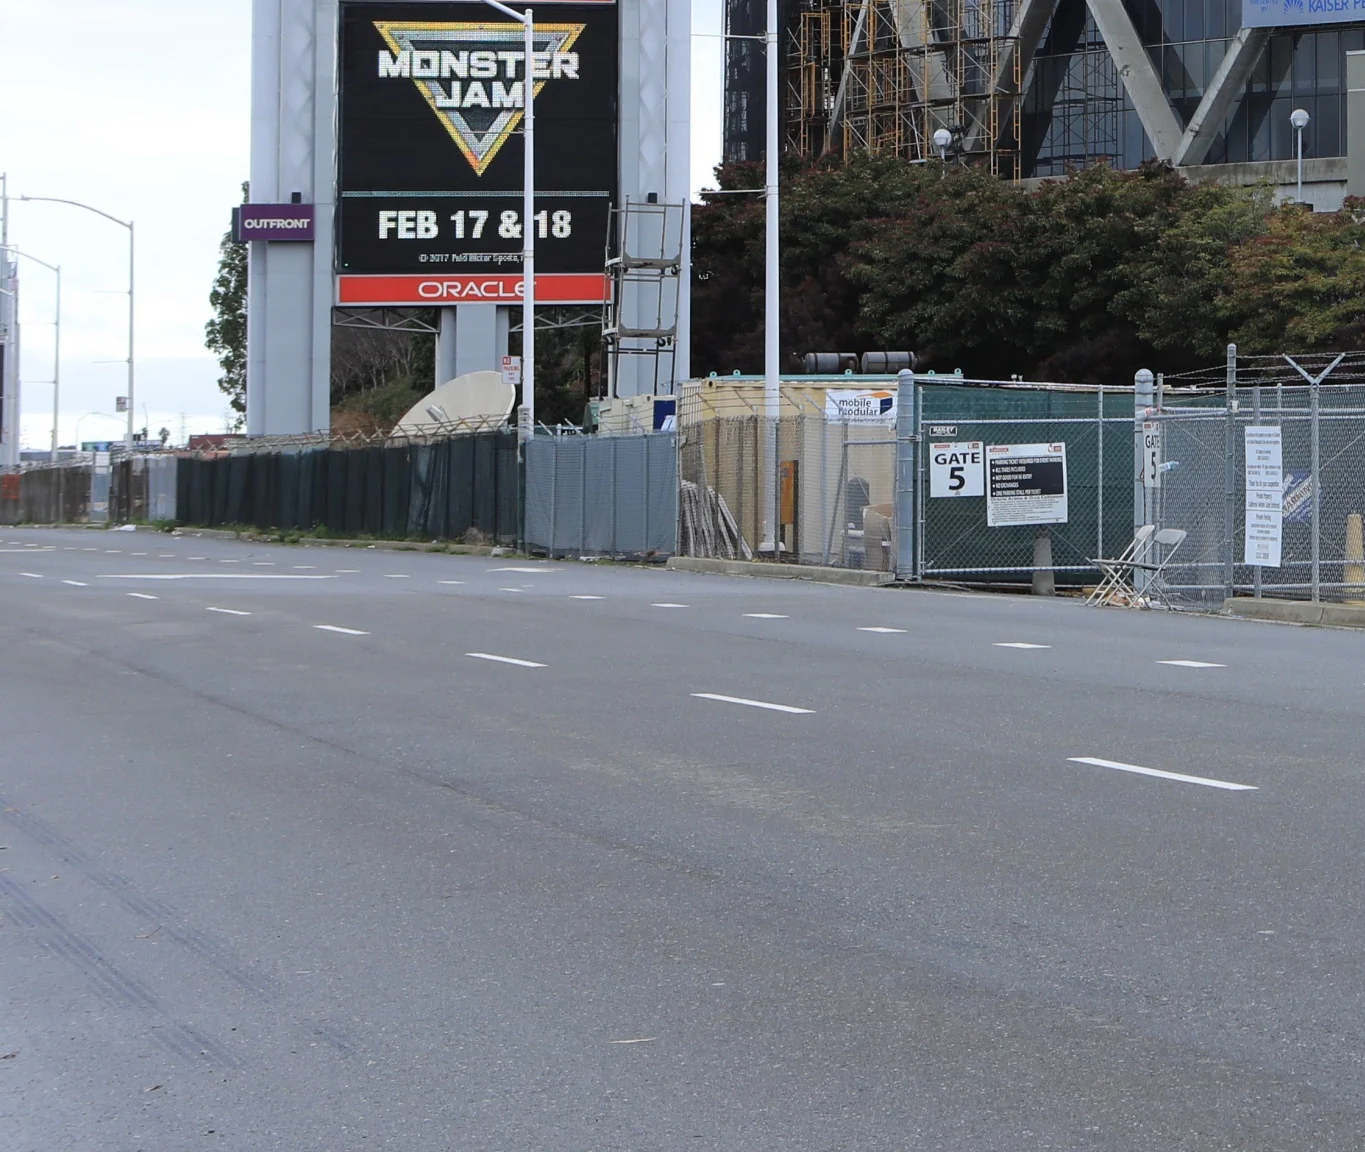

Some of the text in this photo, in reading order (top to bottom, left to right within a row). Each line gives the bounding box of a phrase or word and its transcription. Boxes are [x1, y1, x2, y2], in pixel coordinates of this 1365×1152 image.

[378, 49, 580, 80] MONSTER
[435, 80, 525, 108] JAM
[243, 217, 311, 229] OUTFRONT
[379, 209, 572, 239] FEB 17 & 18
[838, 397, 872, 408] mobile
[1145, 434, 1160, 449] GATE
[934, 452, 981, 466] GATE
[1150, 451, 1157, 480] 5
[948, 466, 966, 491] 5
